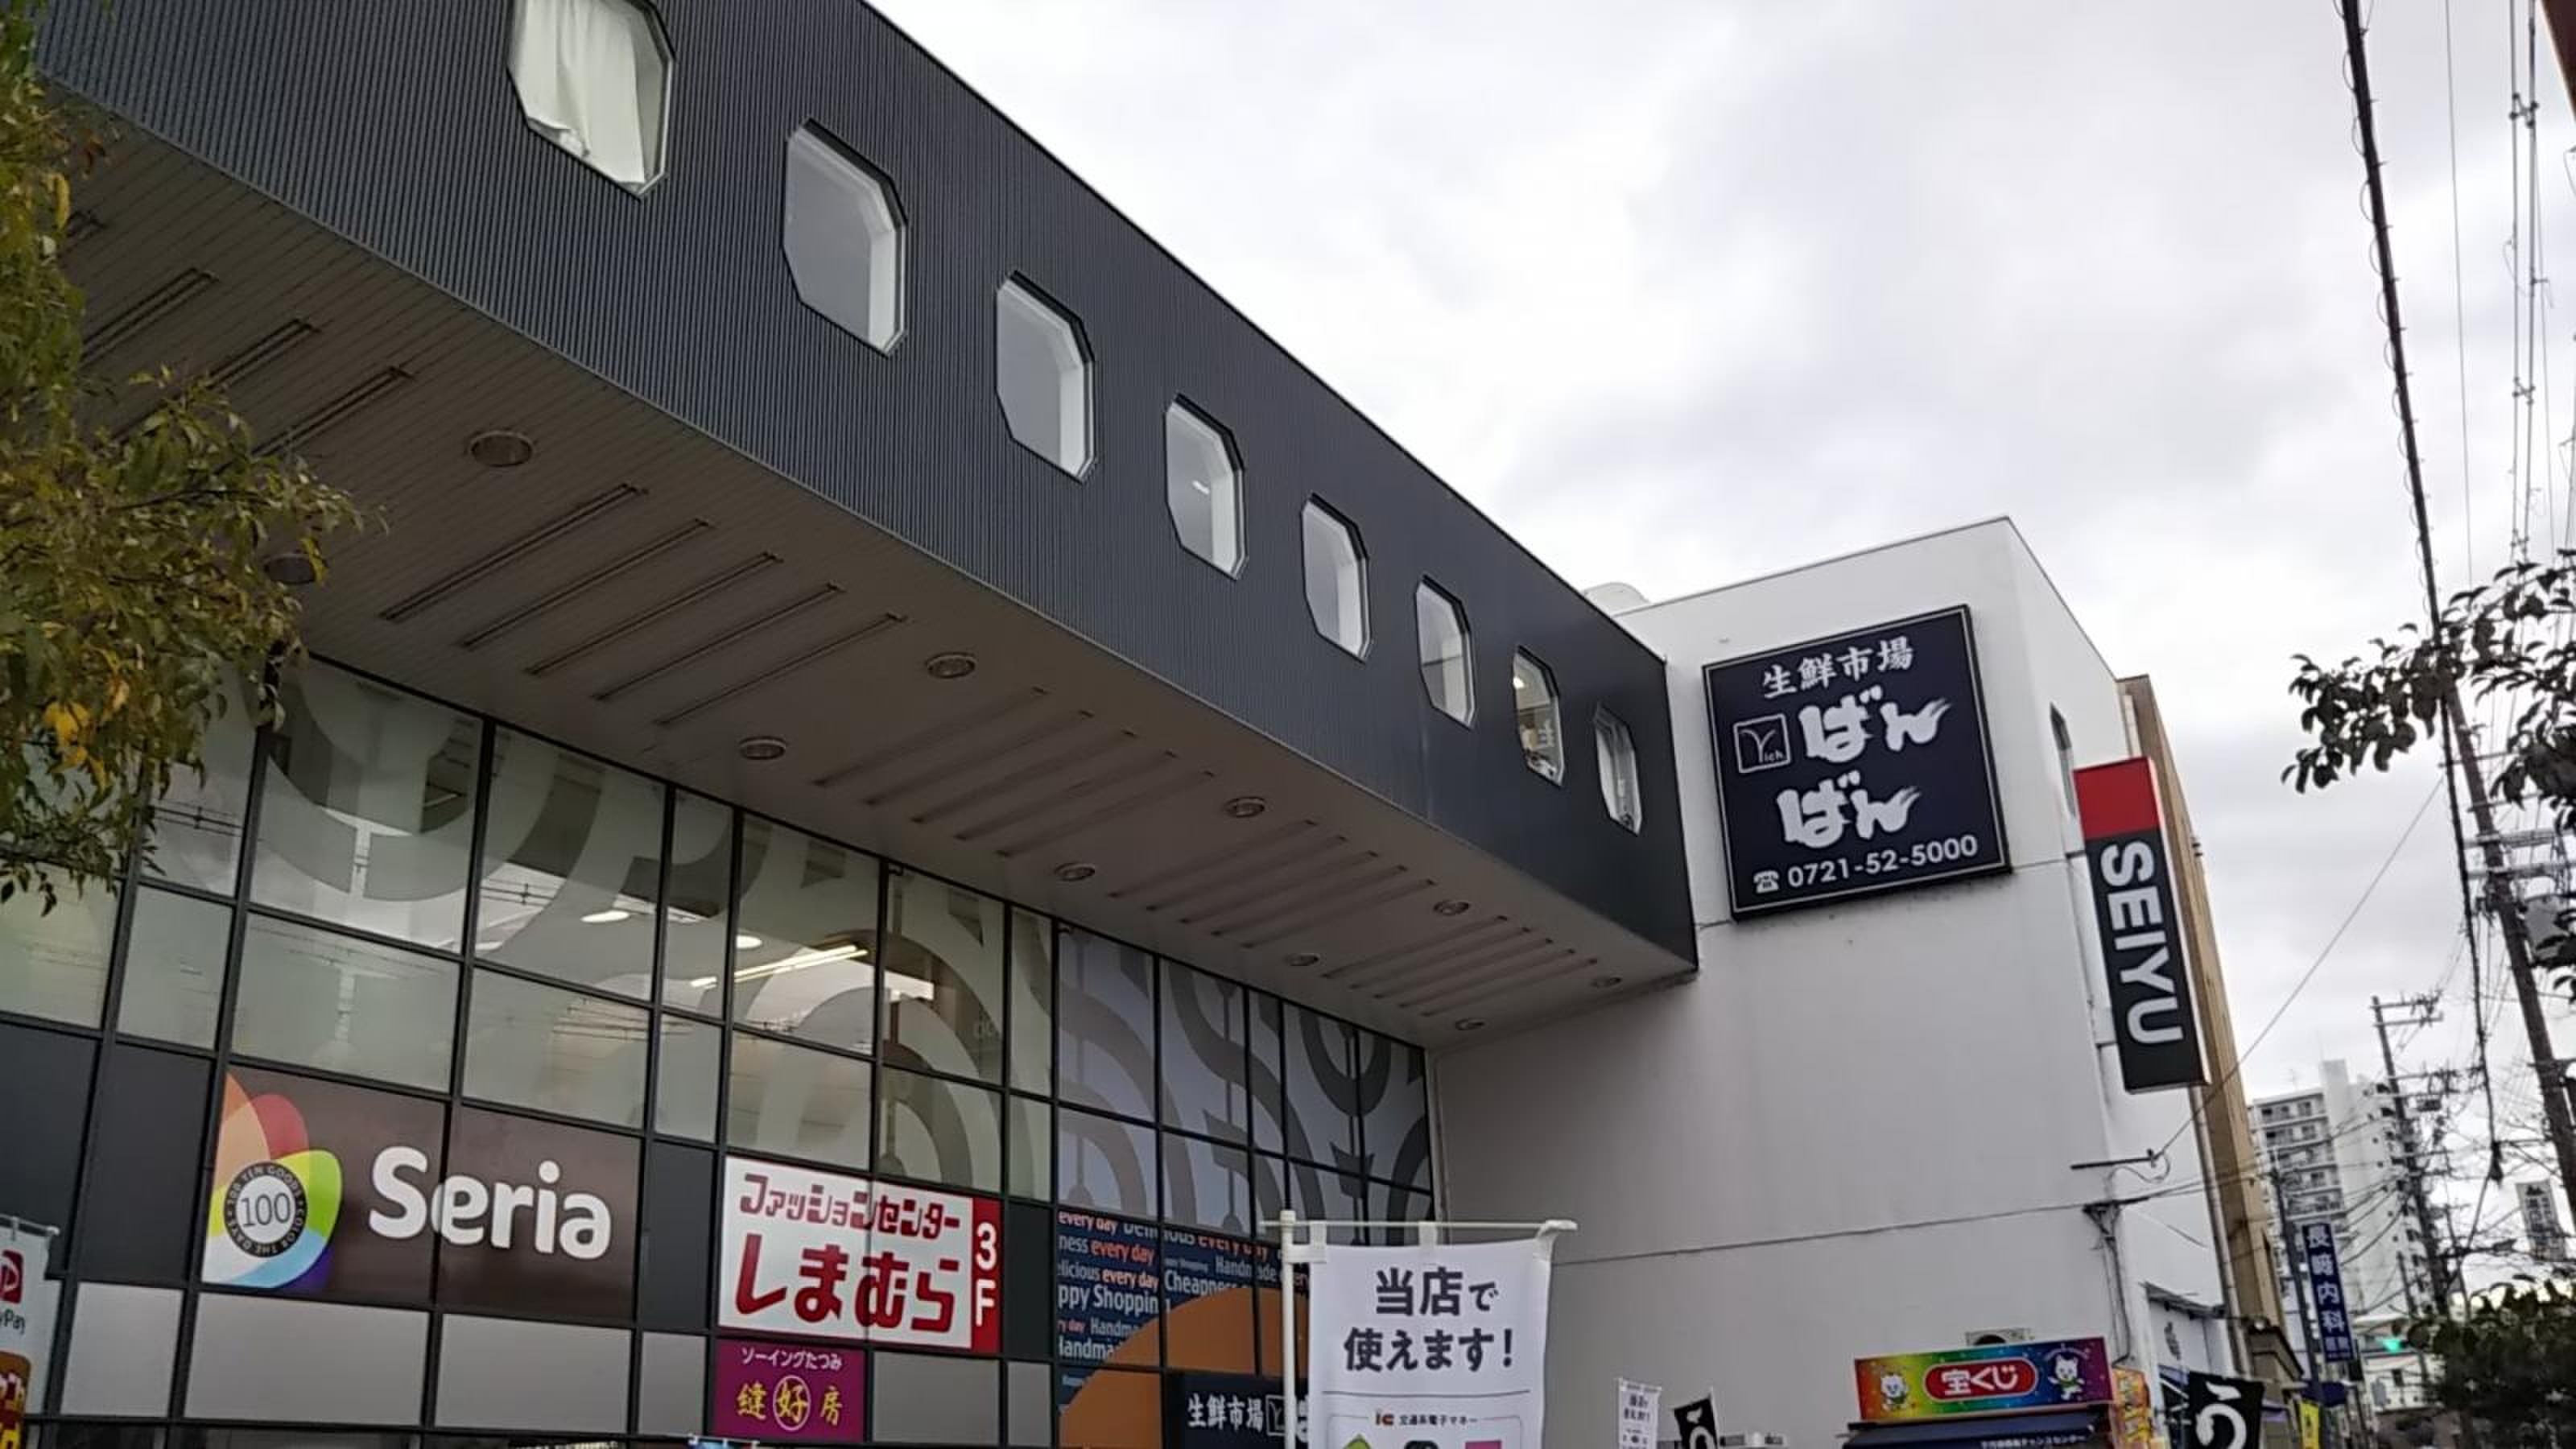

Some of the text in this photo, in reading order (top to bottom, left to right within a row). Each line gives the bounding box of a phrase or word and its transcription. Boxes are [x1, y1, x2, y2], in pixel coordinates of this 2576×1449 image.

[1762, 634, 1915, 699] 生鮮市場
[1798, 684, 1951, 763] ばん
[1776, 770, 1922, 849] ばん
[1787, 834, 1979, 888] 0721-52-5000
[2099, 840, 2185, 1045] SEIYU
[241, 1192, 291, 1228] 100
[369, 1146, 613, 1260] Seria
[740, 1172, 960, 1241] ファッションセンター
[975, 1222, 997, 1327] 3F
[1090, 1240, 1129, 1262] every
[1130, 1243, 1156, 1267] day
[1101, 1269, 1137, 1290] every
[736, 1232, 960, 1333] しまむら
[1375, 1265, 1499, 1317] 当店で
[741, 1348, 843, 1372] ソーイングたつみ
[1343, 1327, 1513, 1373] 使えます!
[1941, 1365, 2019, 1397] 宝くじ
[1187, 1393, 1264, 1433] 生鮮市場
